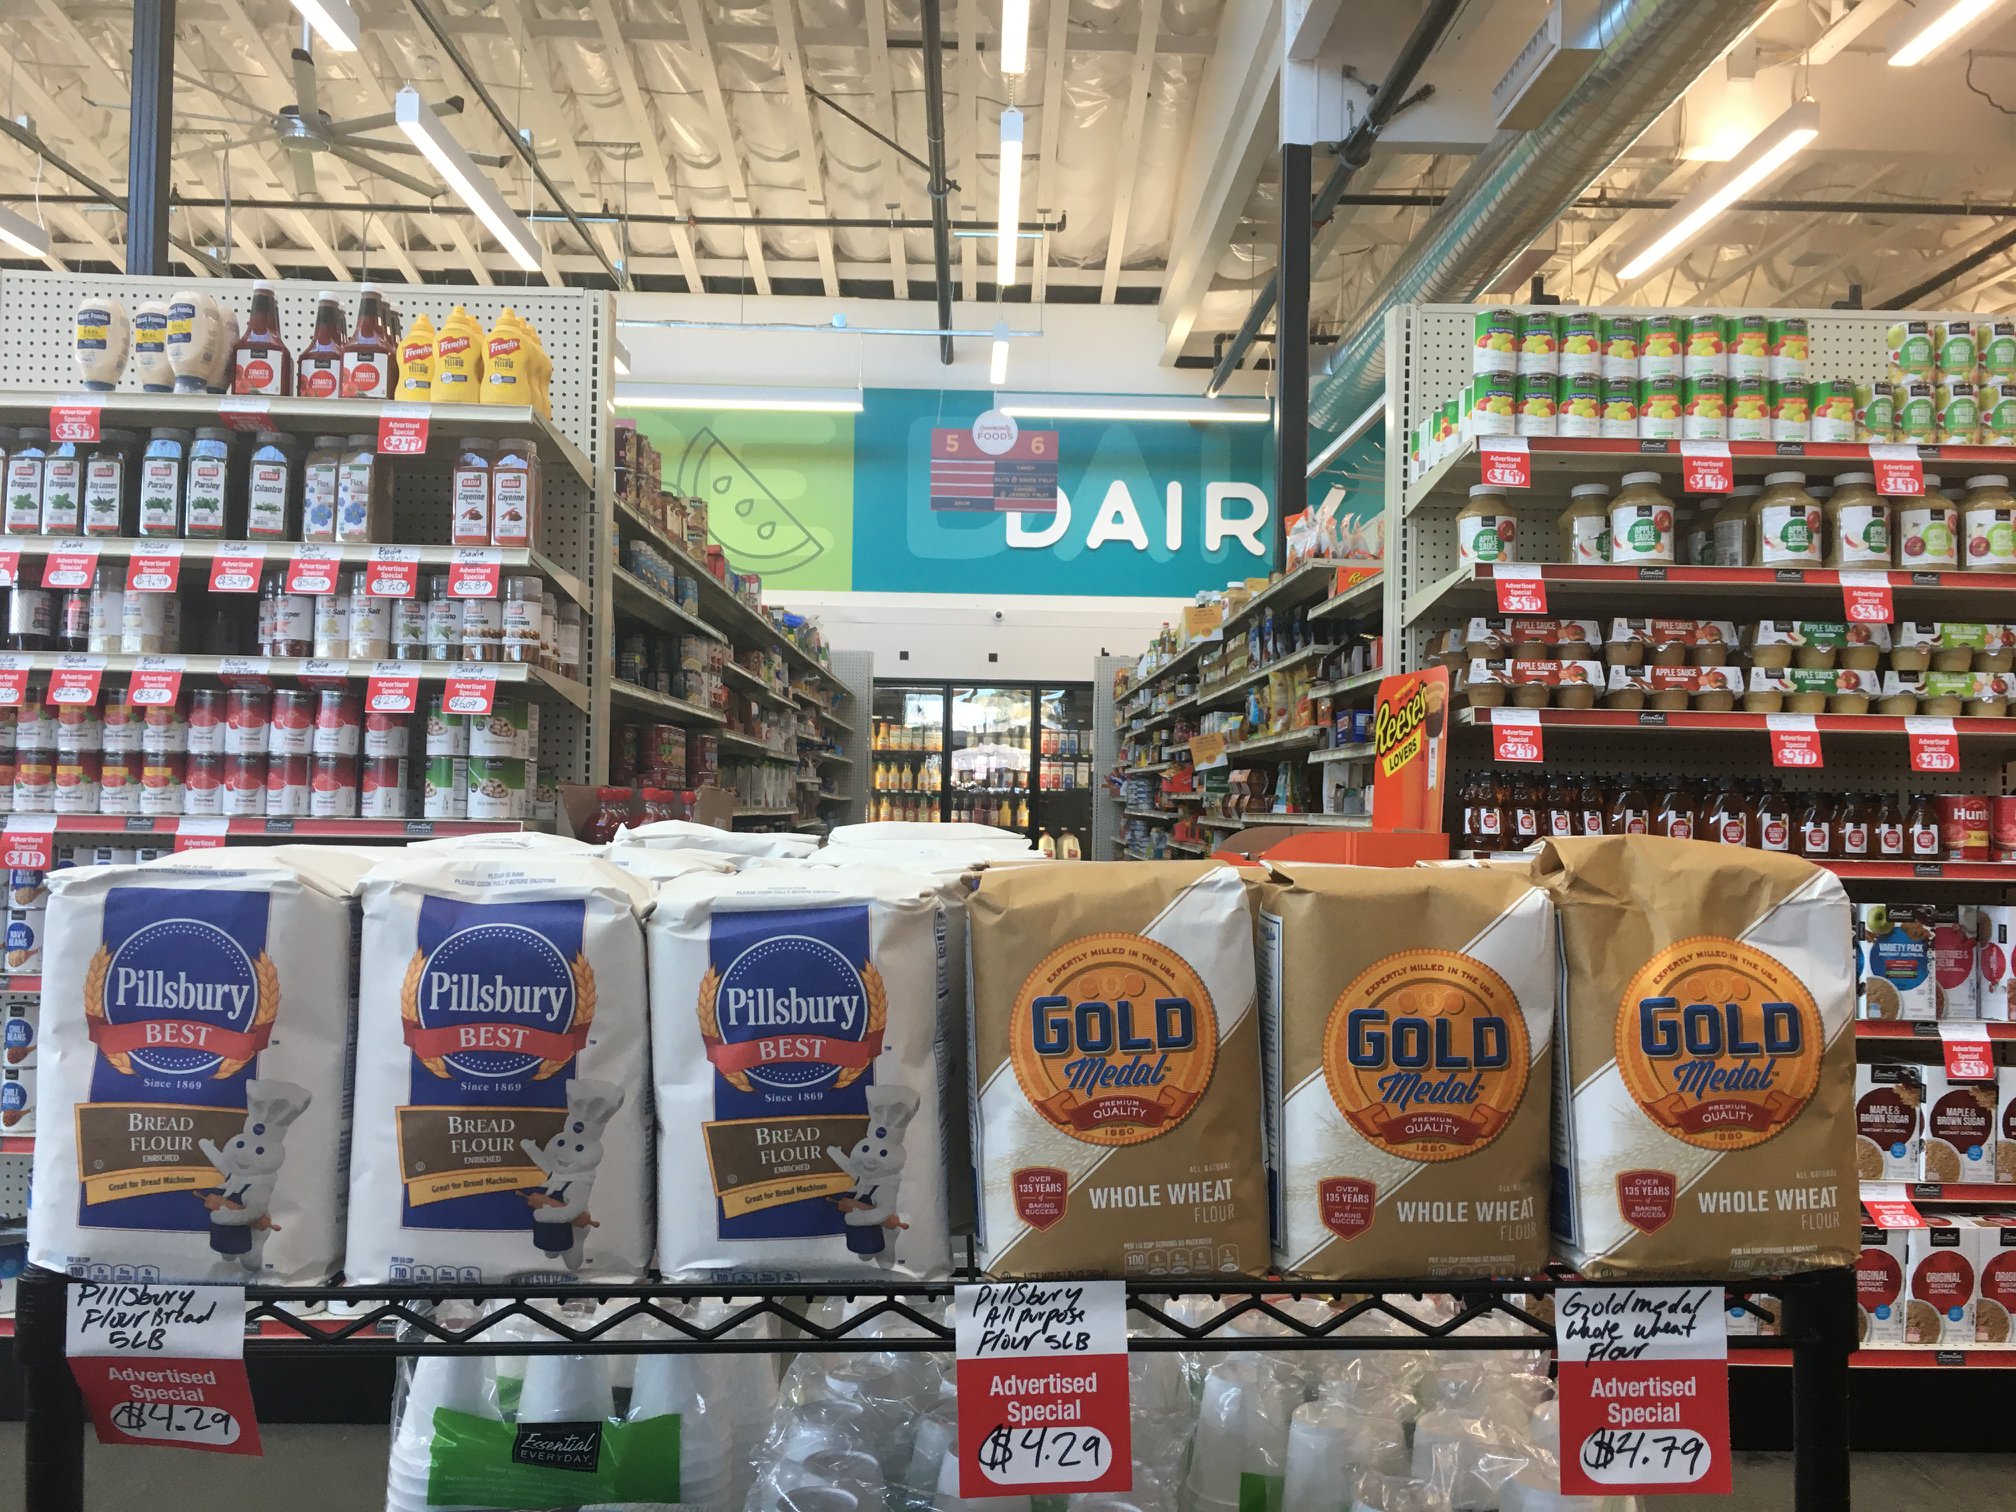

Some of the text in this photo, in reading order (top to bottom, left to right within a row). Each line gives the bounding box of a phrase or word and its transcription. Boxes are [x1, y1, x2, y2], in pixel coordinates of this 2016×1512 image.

[440, 338, 469, 351] French's
[490, 339, 518, 352] French's
[355, 371, 376, 379] TOMATO
[63, 415, 86, 423] Special
[393, 428, 415, 436] Special
[977, 432, 1014, 441] FOODS
[946, 434, 959, 452] 5
[1031, 436, 1045, 455] 6
[458, 492, 485, 502] Cayenne
[497, 493, 525, 503] Cayenne
[1634, 525, 1655, 534] APPLE
[1634, 532, 1655, 542] SAUCE
[459, 566, 491, 574] Advertised
[463, 573, 486, 581] Special
[1505, 582, 1536, 590] Advertised
[1516, 661, 1557, 670] APPLE SAUCE
[1375, 682, 1428, 757] Reese's
[1919, 738, 1949, 746] Advertised
[1924, 745, 1946, 753] Special
[1388, 736, 1418, 771] LOVERS
[1879, 943, 1924, 952] VARIETY PACK
[1046, 947, 1176, 984] EXPERTLY MILLED IN THE USA
[1652, 954, 1693, 984] EXPERTLY
[1730, 953, 1738, 961] IN
[1741, 957, 1759, 970] THE
[1760, 968, 1778, 984] USA
[1365, 964, 1495, 999] EXPERTLY MILLED IN THE USA
[115, 966, 250, 1020] Pillsbury
[429, 971, 568, 1022] Pillsbury
[727, 987, 860, 1030] Pillsbury
[1032, 996, 1196, 1055] GOLD
[1639, 997, 1800, 1057] GOLD
[145, 1023, 213, 1047] BEST
[459, 1026, 529, 1049] BEST
[1348, 1008, 1510, 1070] GOLD
[759, 1038, 827, 1061] BEST
[144, 1078, 202, 1090] Since 1869
[1064, 1054, 1168, 1098] Medal
[1673, 1059, 1776, 1100] Medal
[461, 1081, 522, 1092] Since 1869
[1378, 1072, 1482, 1112] Medal
[765, 1092, 824, 1102] Since 1869
[1100, 1099, 1139, 1108] PREMIUM
[1092, 1107, 1147, 1120] QUALITY
[1708, 1104, 1746, 1112] PREMIUM
[1869, 1105, 1900, 1114] MAPLE &
[1412, 1116, 1452, 1124] PREMIUM
[1702, 1111, 1754, 1123] QUALITY
[1860, 1114, 1909, 1124] BROWN SUGAR
[1105, 1127, 1134, 1136] 1880
[1405, 1123, 1460, 1135] QUALITY
[1714, 1132, 1743, 1140] 1880
[130, 1136, 192, 1152] FLOUR
[451, 1138, 514, 1154] FLOUR
[1416, 1144, 1446, 1152] 1880
[142, 1153, 180, 1163] ENRICHED
[464, 1155, 502, 1165] ENRICHED
[761, 1146, 822, 1165] FLOUR
[774, 1163, 810, 1174] ENRICHED
[108, 1175, 196, 1192] Great for Bread Machines
[432, 1176, 518, 1193] Great for Bread Machines
[1019, 1182, 1062, 1193] 135 YEARS
[1636, 1178, 1658, 1186] OVER
[744, 1183, 828, 1204] Great for Bread Machines
[1088, 1178, 1233, 1210] WHOLE WHEAT
[1326, 1193, 1369, 1204] 135 YEARS
[1624, 1186, 1670, 1196] 135 YEARS
[1698, 1186, 1838, 1214] WHOLE WHEAT
[1026, 1208, 1059, 1216] SUCCESS
[1194, 1203, 1236, 1224] FLOUR
[1397, 1196, 1534, 1222] WHOLE WHEAT
[1330, 1218, 1364, 1226] SUCCESS
[1802, 1212, 1840, 1230] FLOUR
[1500, 1222, 1537, 1241] FLOUR
[1926, 1272, 1961, 1282] ORIGINAL
[81, 1301, 217, 1333] Flour Bread
[983, 1306, 1013, 1328] All
[109, 1328, 166, 1351] 5LB
[976, 1329, 1043, 1356] Flour
[108, 1367, 217, 1386] Advertised
[989, 1372, 1098, 1397] Advertised
[129, 1384, 205, 1402] Special
[1590, 1376, 1697, 1398] Advertised
[112, 1400, 232, 1436] $4.29
[1007, 1399, 1081, 1426] Special
[1607, 1402, 1681, 1427] Special
[520, 1432, 595, 1453] Essential
[977, 1423, 1101, 1473] $4.29
[520, 1450, 590, 1463] EVERYDAY
[1583, 1427, 1704, 1475] $4.79
